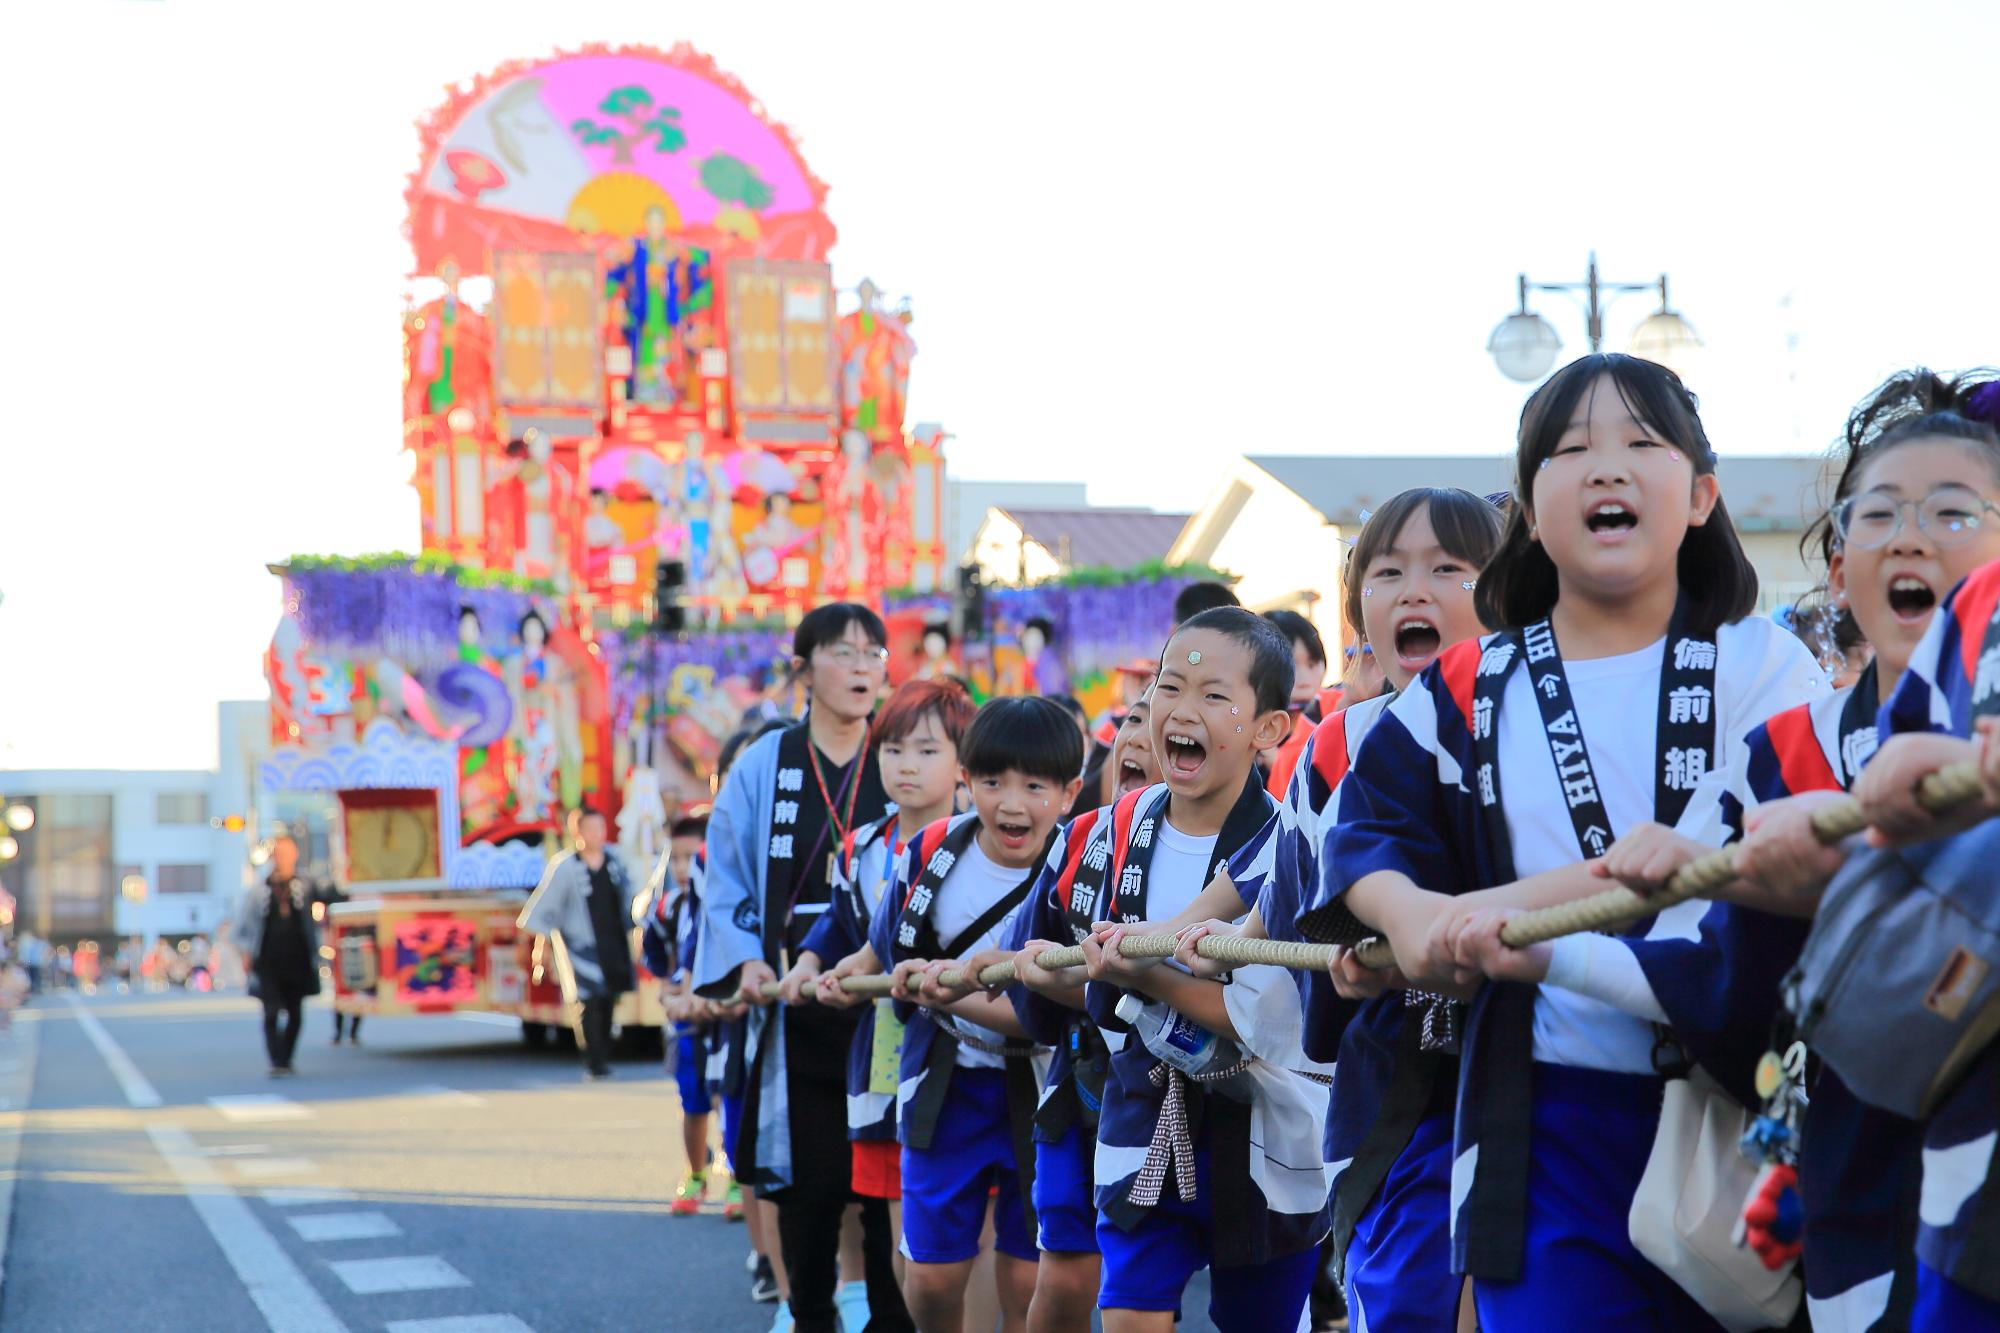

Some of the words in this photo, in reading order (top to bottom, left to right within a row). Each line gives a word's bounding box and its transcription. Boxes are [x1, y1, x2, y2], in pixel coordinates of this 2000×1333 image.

[1523, 619, 1556, 664] HIY
[1547, 709, 1599, 808] HIYA
[1664, 637, 1717, 791] 備前組
[769, 767, 804, 859] 備前組
[898, 847, 956, 948] 備前組
